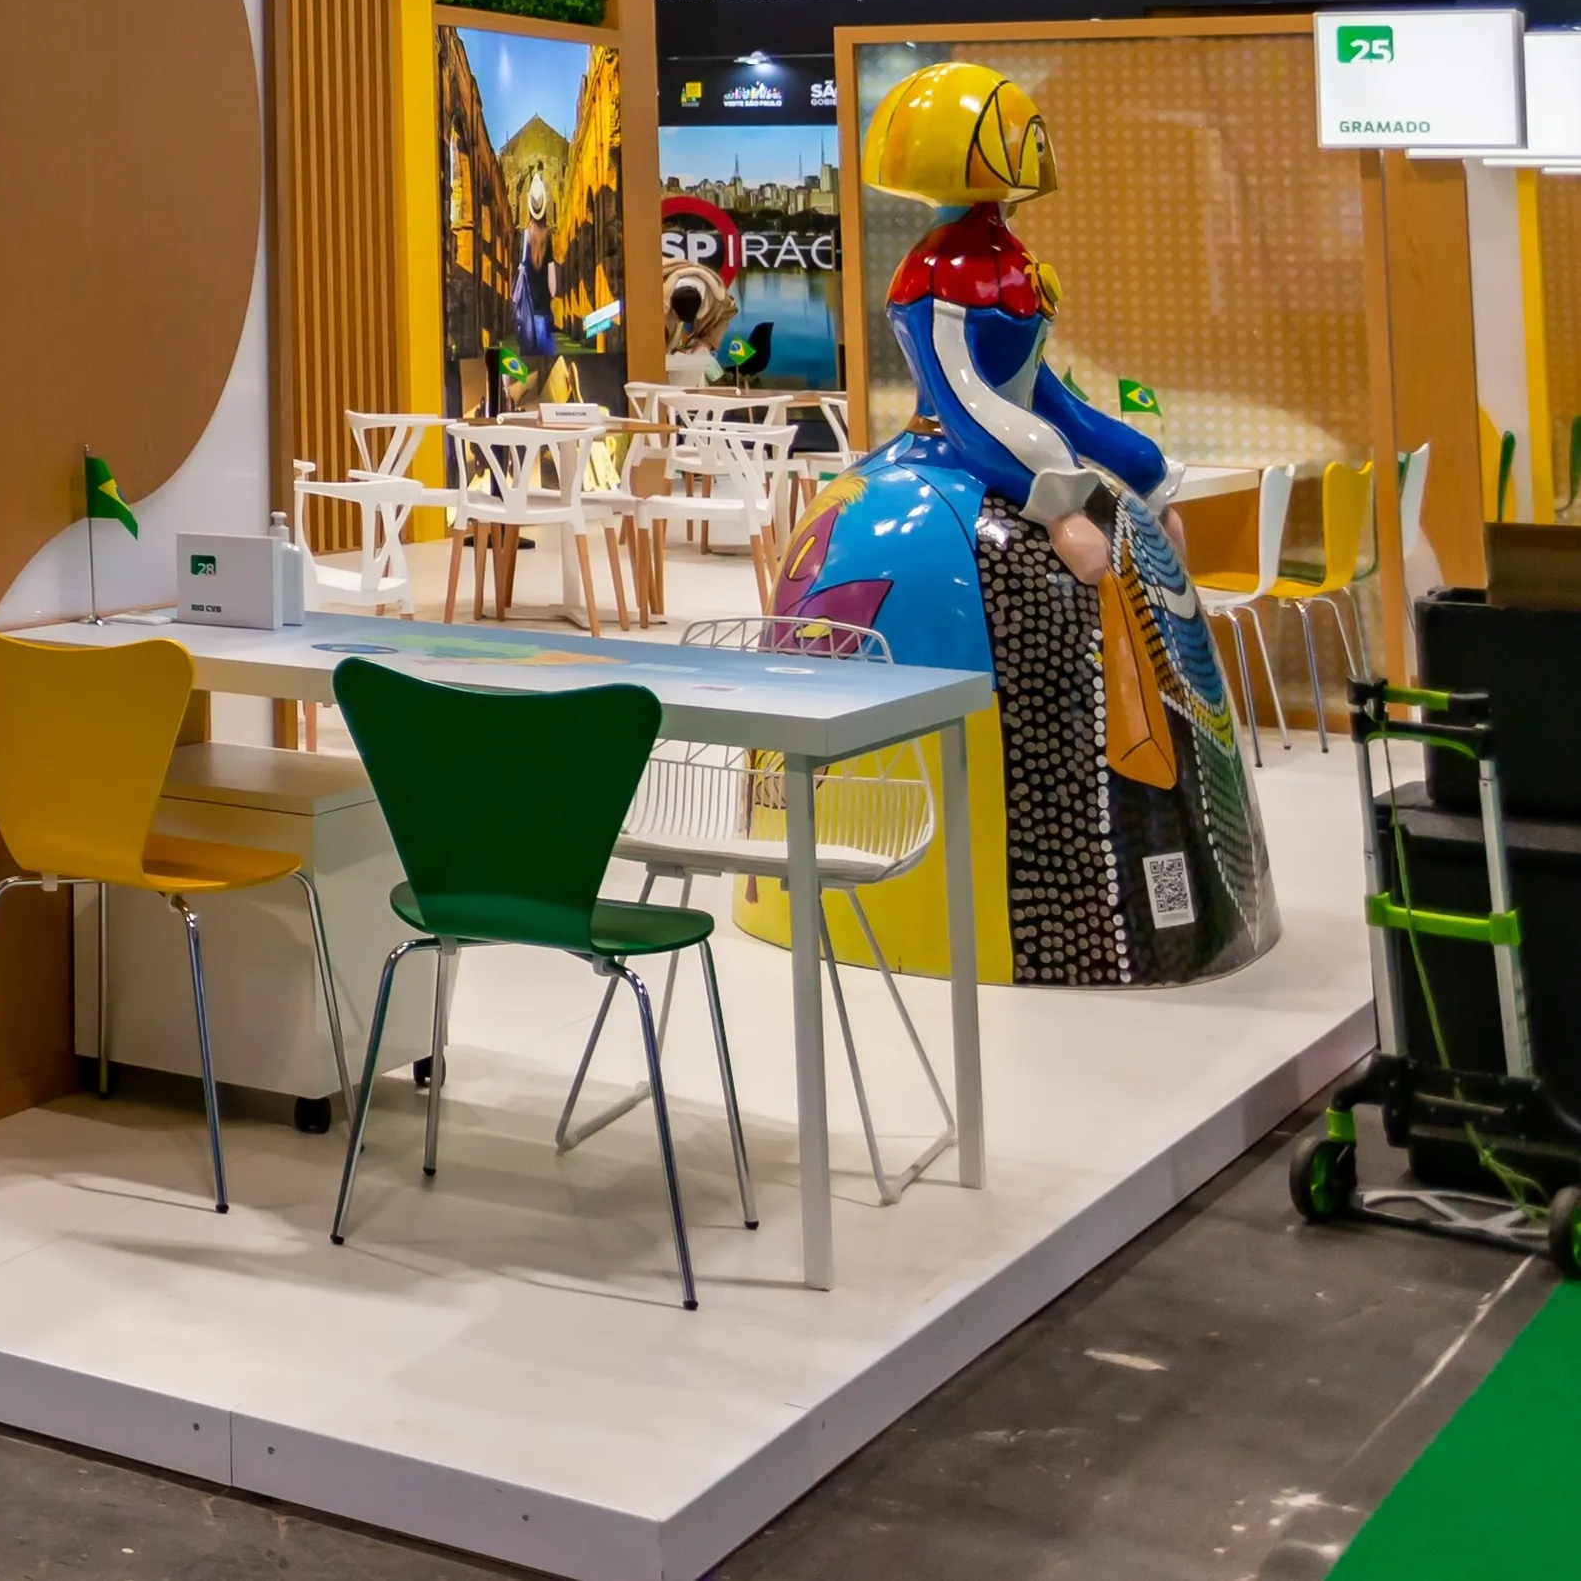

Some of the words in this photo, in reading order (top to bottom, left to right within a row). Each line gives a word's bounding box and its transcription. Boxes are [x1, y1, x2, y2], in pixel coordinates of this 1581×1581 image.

[1349, 39, 1392, 64] 25
[810, 79, 837, 98] SÃ
[1339, 121, 1431, 134] GRAMADO
[197, 562, 216, 576] 28
